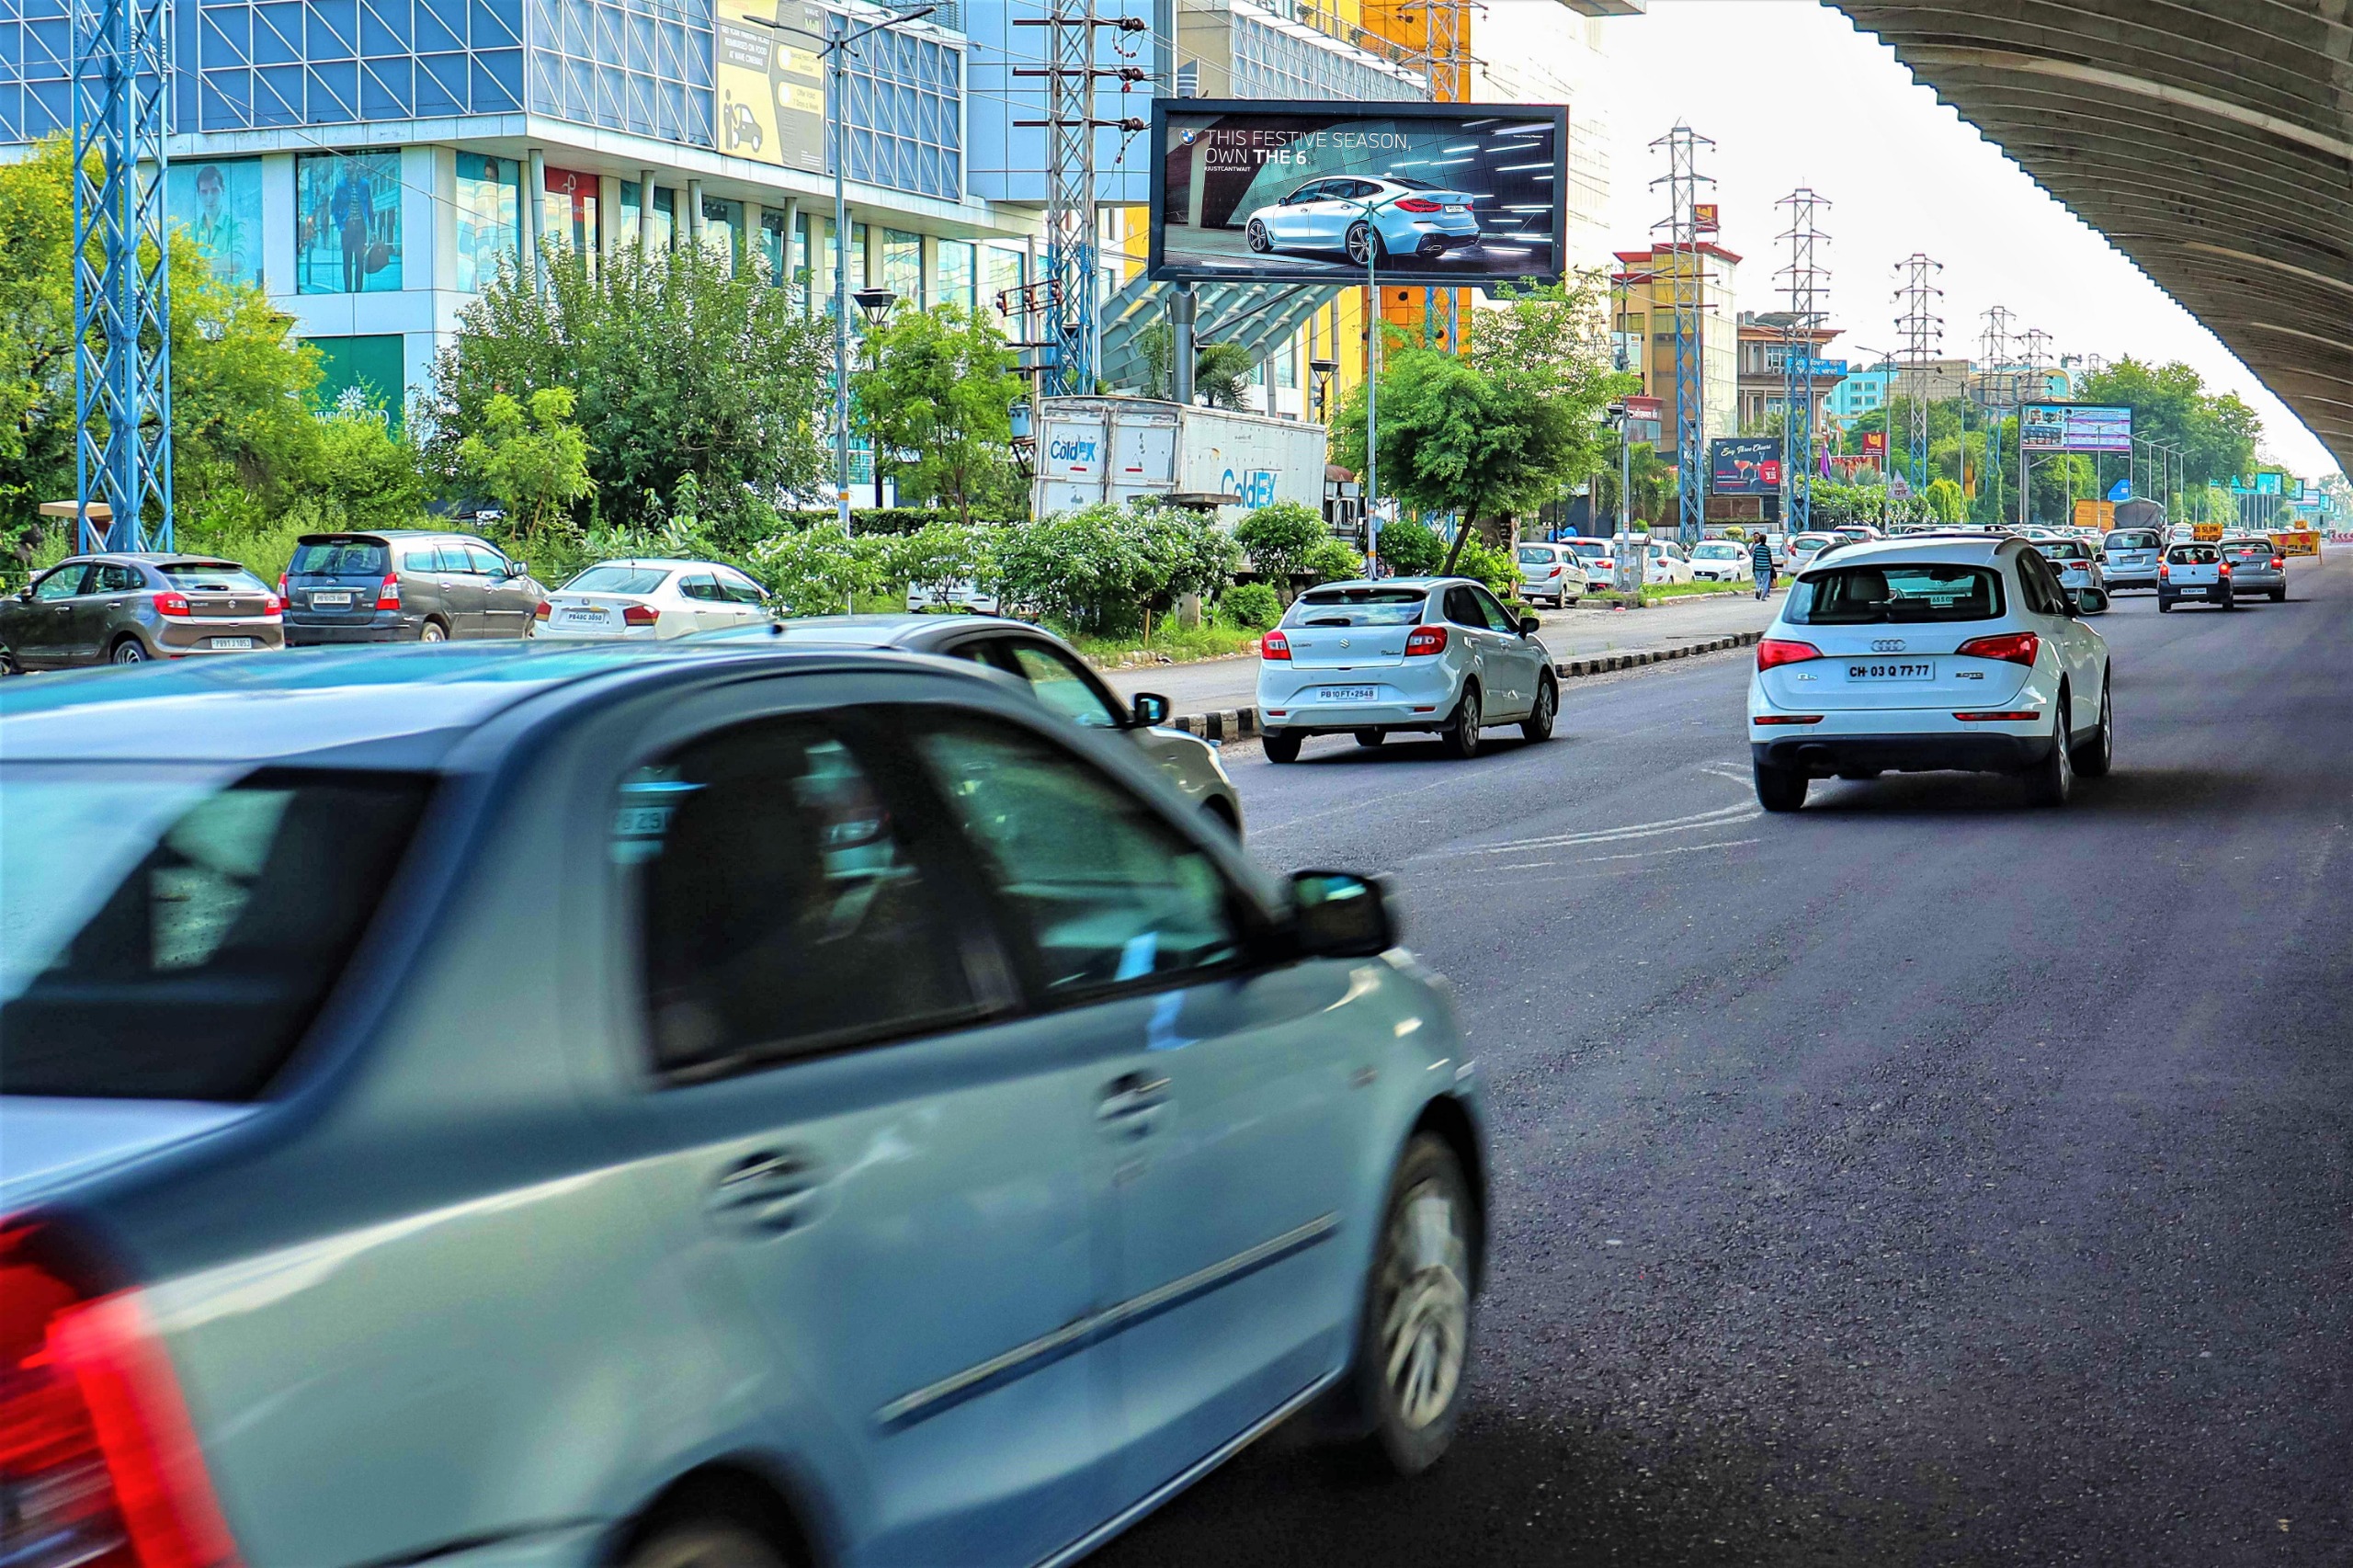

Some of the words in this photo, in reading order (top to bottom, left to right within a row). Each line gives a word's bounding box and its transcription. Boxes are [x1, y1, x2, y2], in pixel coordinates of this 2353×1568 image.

[1204, 130, 1246, 146] THIS
[1253, 131, 1328, 148] FESTIVE
[1332, 131, 1412, 152] SEASON,
[1204, 148, 1248, 164] OWN
[1253, 149, 1290, 165] THE
[1736, 445, 1752, 454] Three
[1752, 443, 1772, 452] Cheers
[1870, 665, 1884, 676] 03
[1888, 665, 1896, 676] Q
[1354, 689, 1374, 698] 2548
